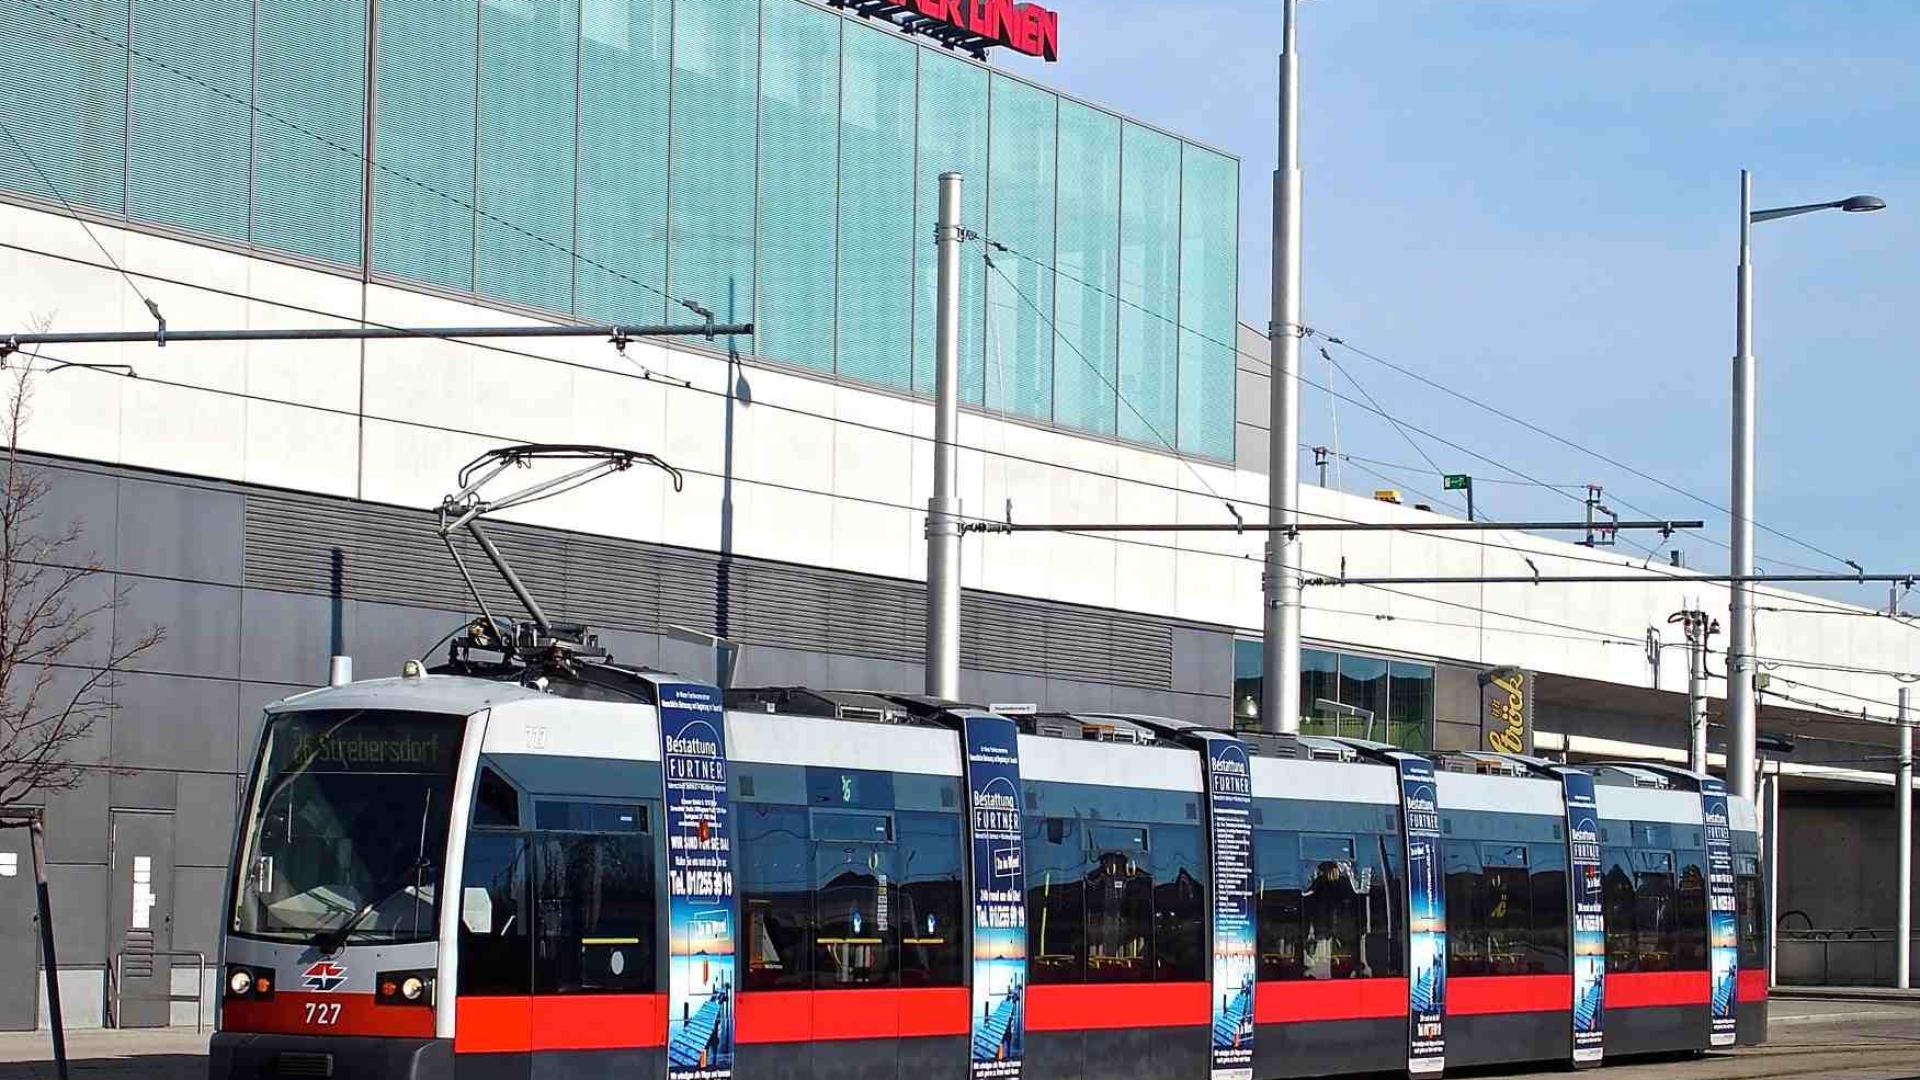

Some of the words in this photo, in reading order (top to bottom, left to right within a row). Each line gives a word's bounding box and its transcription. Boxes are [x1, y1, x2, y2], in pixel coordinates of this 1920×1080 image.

[969, 0, 1058, 62] LINIEN
[666, 735, 716, 760] Bestattung
[669, 758, 724, 780] FURTNER
[1214, 774, 1250, 793] FURTNER
[974, 790, 1015, 809] Bestattung
[976, 810, 1019, 830] FURTNER
[670, 870, 686, 895] Tel.
[305, 1002, 342, 1025] 727
